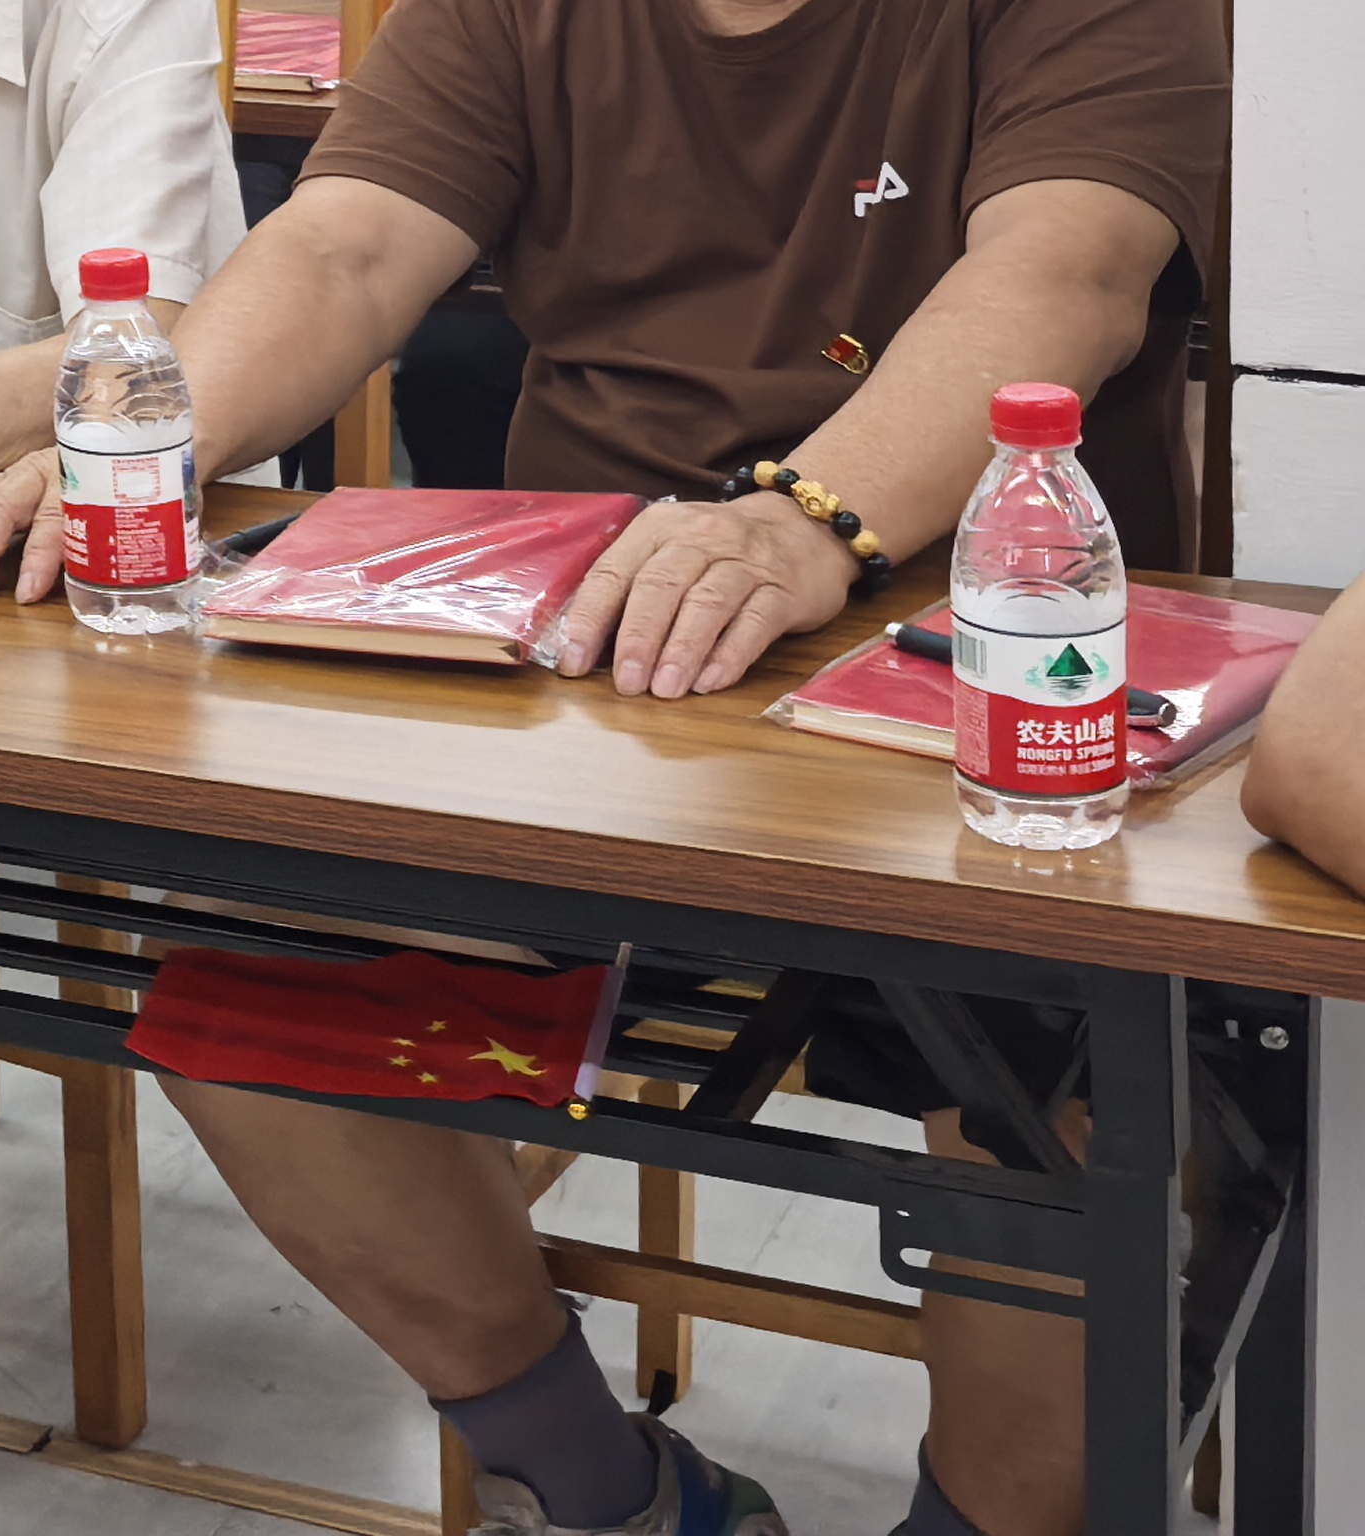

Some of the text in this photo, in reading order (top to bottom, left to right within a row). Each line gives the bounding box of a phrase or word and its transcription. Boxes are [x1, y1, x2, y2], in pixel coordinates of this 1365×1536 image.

[1016, 710, 1115, 746] 农夫山泉
[1016, 746, 1073, 762] NONGFU
